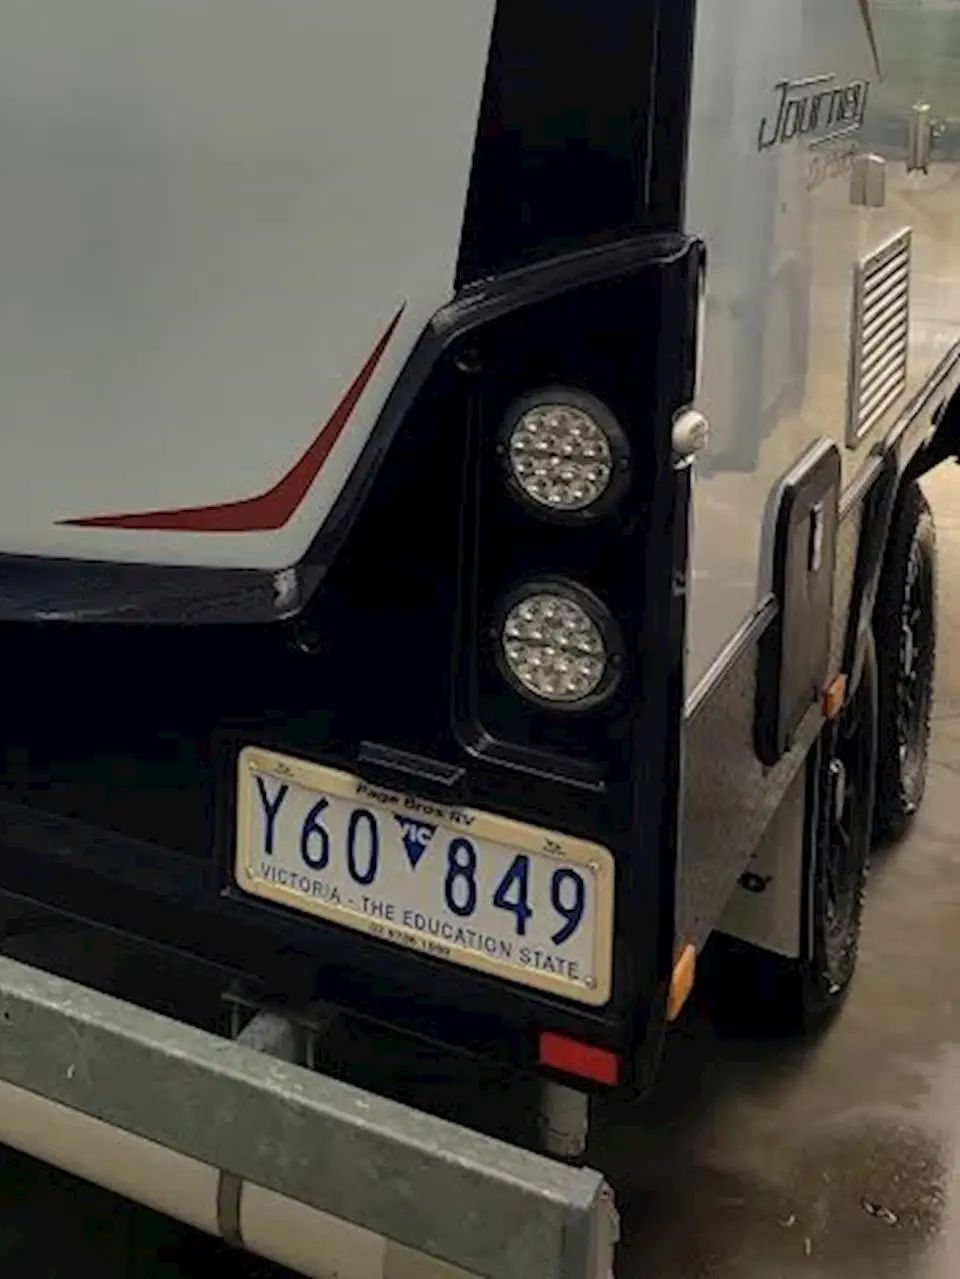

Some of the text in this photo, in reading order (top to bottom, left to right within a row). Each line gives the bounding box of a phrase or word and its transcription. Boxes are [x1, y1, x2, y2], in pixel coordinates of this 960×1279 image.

[255, 776, 380, 886] Y60
[444, 837, 586, 947] 849
[355, 783, 477, 826] Page Bros RV
[259, 862, 343, 905] VICTORIA
[360, 896, 397, 922] THE
[403, 909, 512, 959] EDUCATION
[519, 948, 581, 980] STATE
